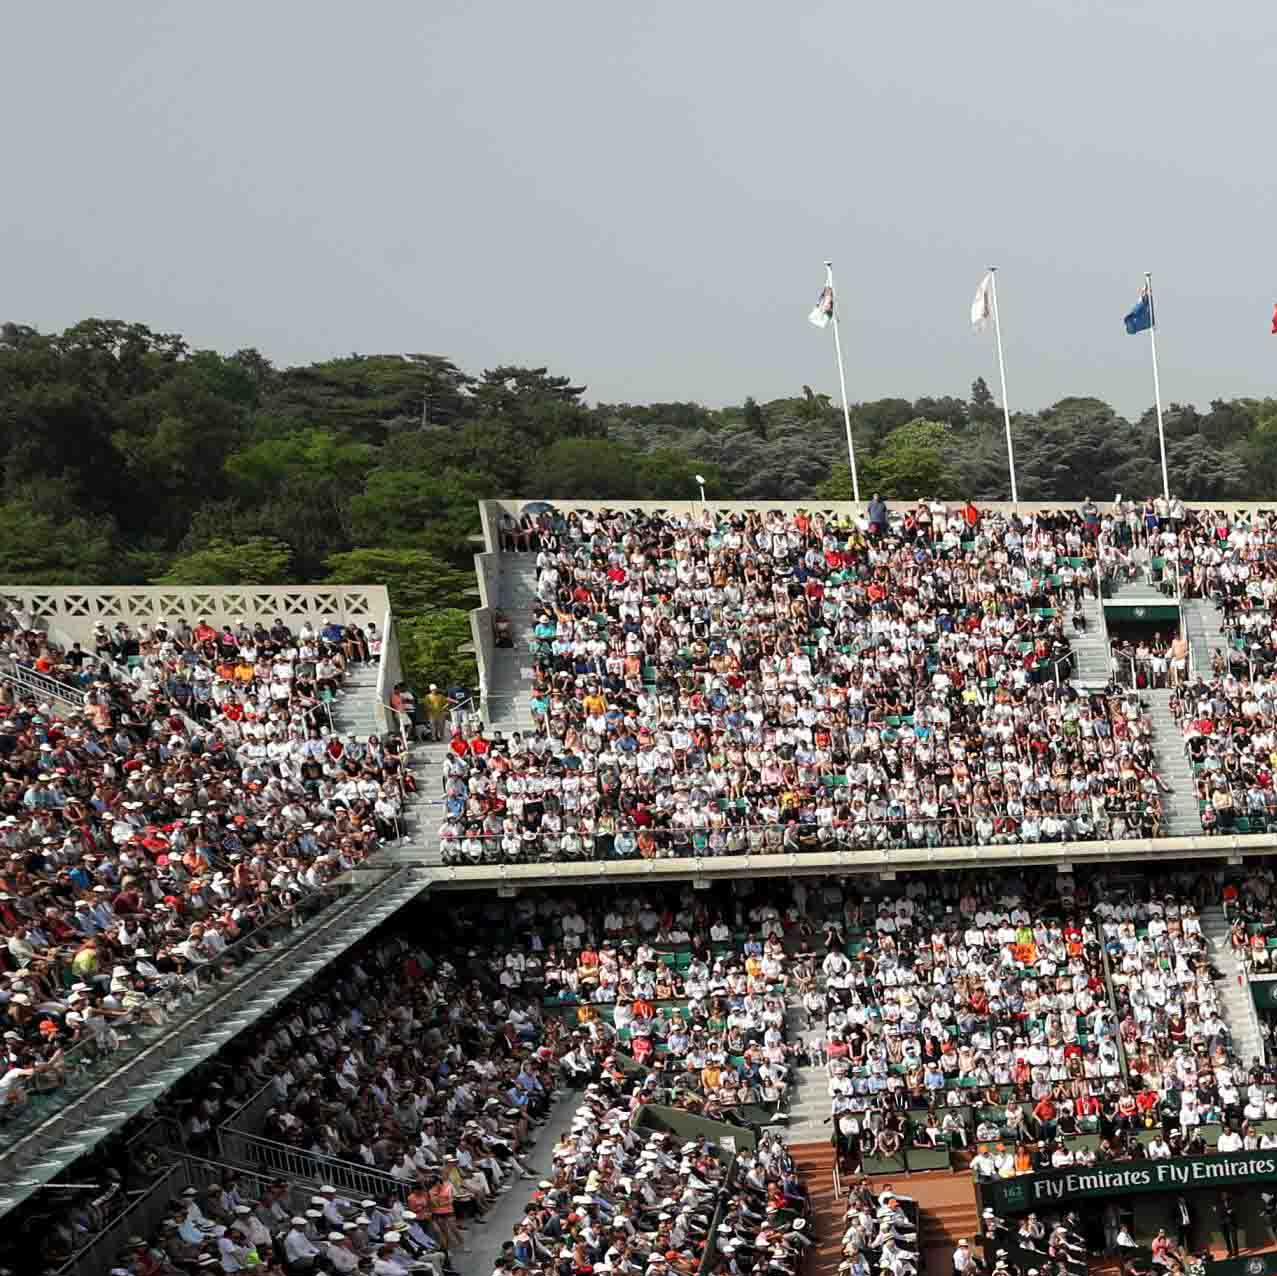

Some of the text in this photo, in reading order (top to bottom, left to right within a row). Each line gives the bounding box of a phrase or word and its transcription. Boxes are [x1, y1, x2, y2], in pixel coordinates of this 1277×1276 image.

[1033, 1169, 1150, 1199] Fly Emirates
[1157, 1158, 1275, 1184] Fly Emirates
